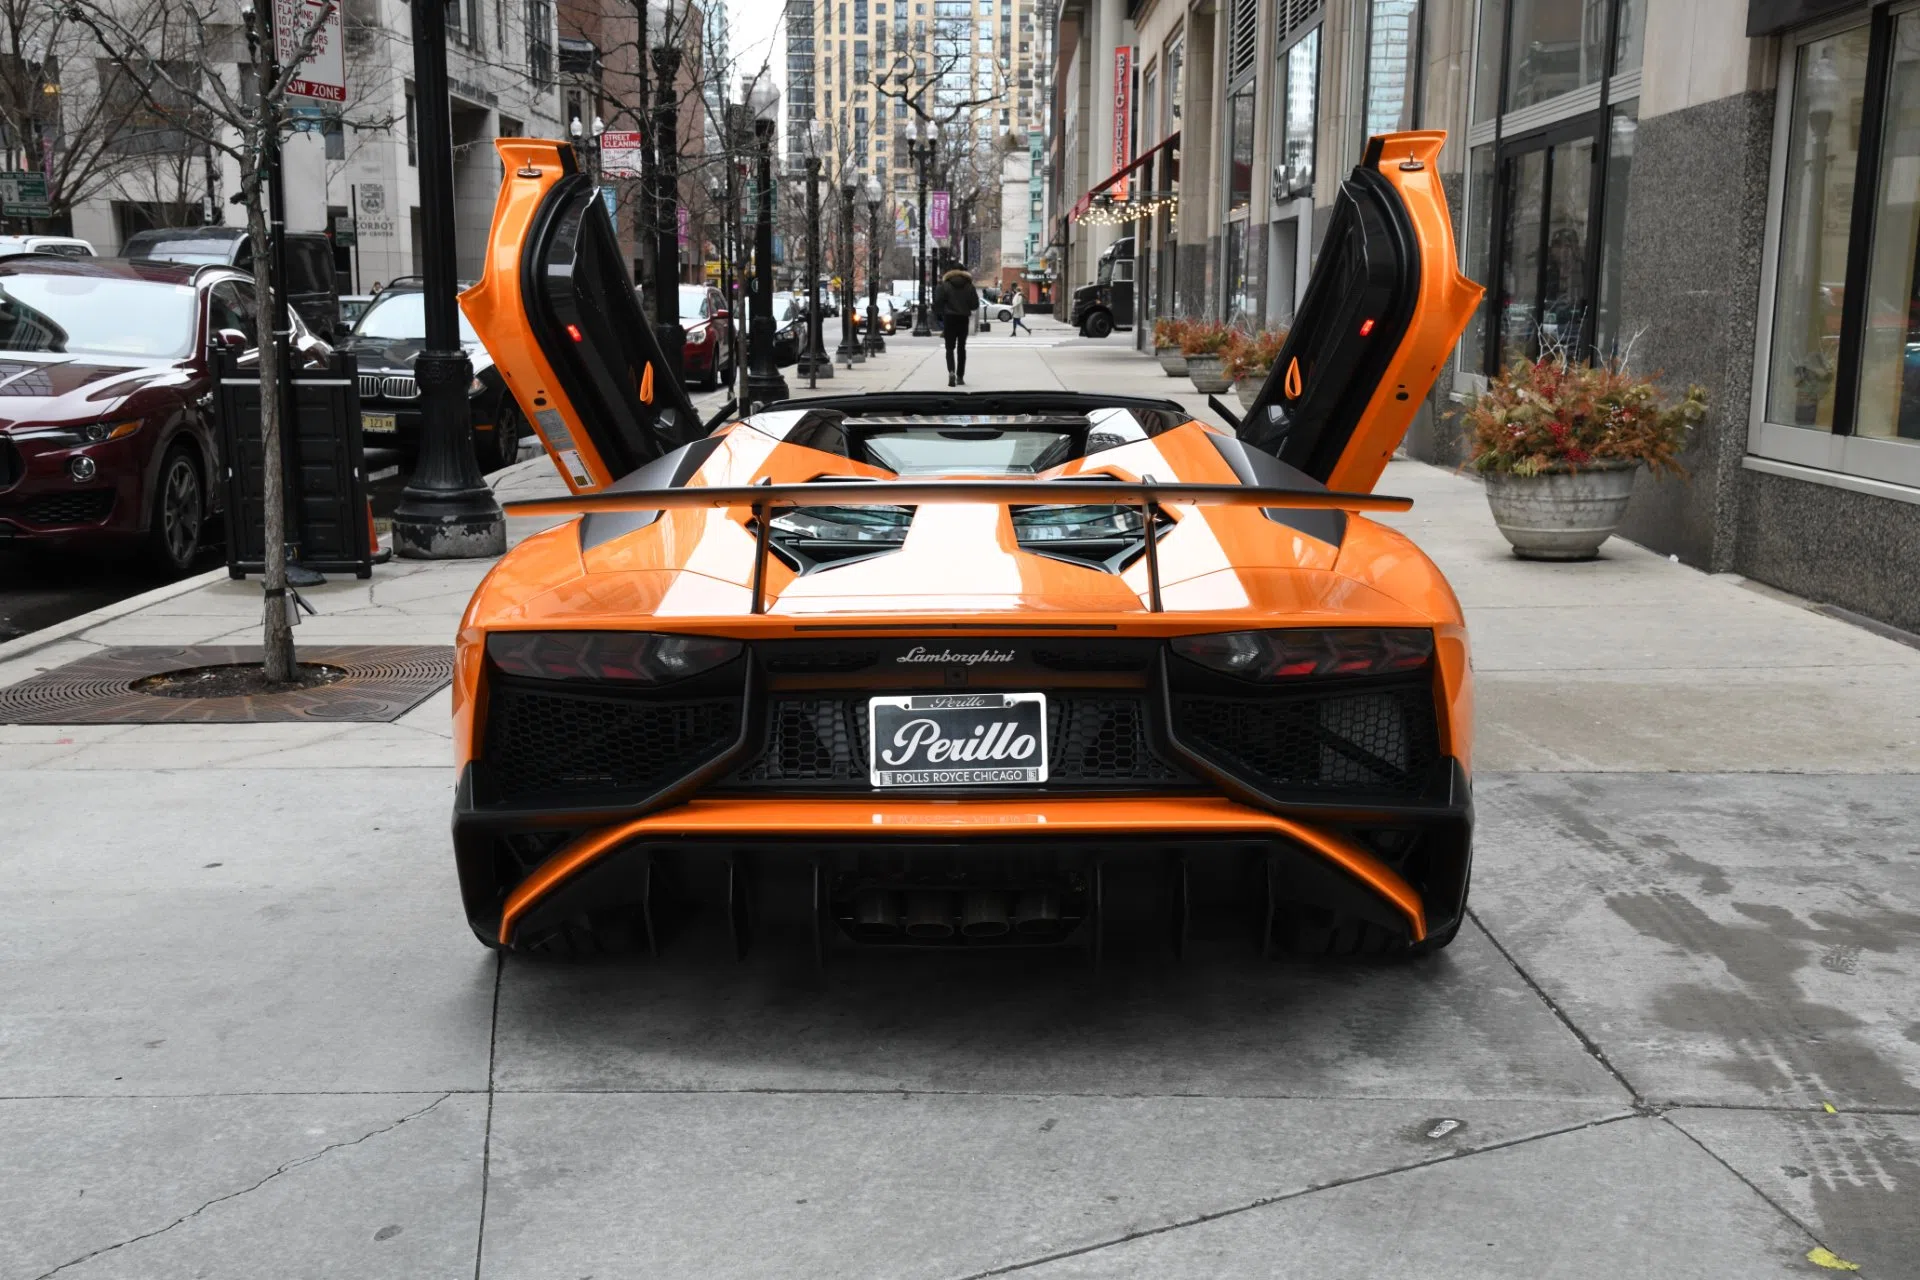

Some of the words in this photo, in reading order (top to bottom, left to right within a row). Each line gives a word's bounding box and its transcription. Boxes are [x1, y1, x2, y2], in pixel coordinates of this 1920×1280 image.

[278, 5, 313, 20] FLAING
[1116, 53, 1125, 108] EPIC
[288, 81, 306, 94] OW
[312, 84, 341, 99] ZONE
[1113, 113, 1124, 193] BURGR
[896, 646, 1015, 665] Lamborghini
[929, 696, 985, 708] Perillo
[881, 718, 1036, 766] Perillo
[896, 773, 929, 783] ROLLS
[933, 772, 970, 782] ROYCE
[973, 770, 1023, 781] CHICAGO
